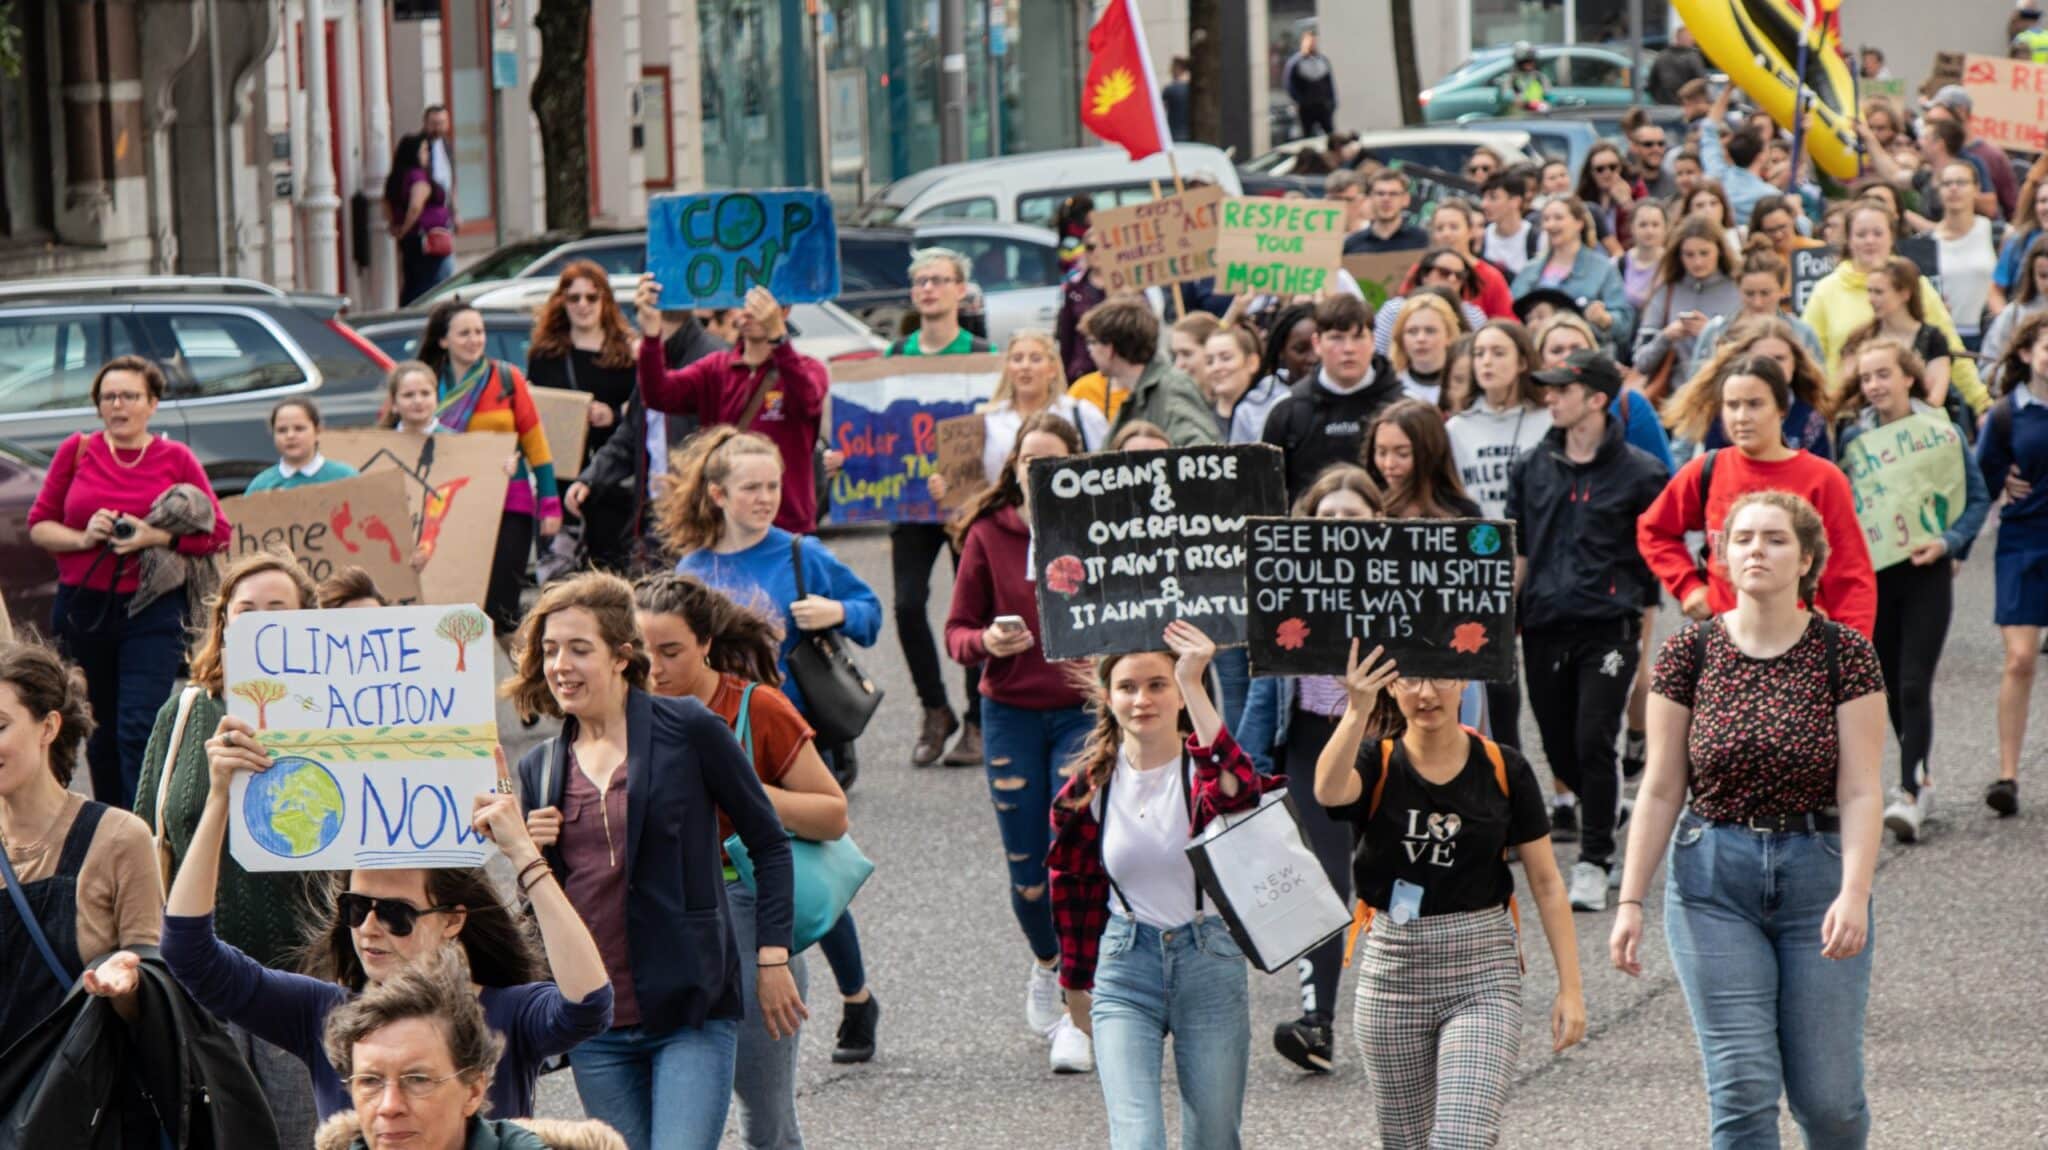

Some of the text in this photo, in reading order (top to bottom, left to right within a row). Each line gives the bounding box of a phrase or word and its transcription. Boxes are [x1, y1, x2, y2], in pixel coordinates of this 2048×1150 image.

[680, 193, 813, 252] COP
[1100, 202, 1218, 250] LITTLE ACT
[1225, 202, 1341, 232] RESPECT
[1256, 234, 1304, 253] YOUR
[687, 237, 777, 299] ON
[1225, 261, 1327, 293] MOTHER
[838, 421, 898, 458] Solar
[1896, 425, 1957, 457] Maths
[1051, 455, 1238, 499] OCEANS RISE
[1150, 483, 1176, 512] &
[1087, 514, 1247, 545] OVERFLOW
[1253, 525, 1457, 553] SEE HOW THE
[1084, 555, 1107, 585] IT
[1111, 547, 1179, 577] AIN'T
[1255, 557, 1513, 587] COULD BE IN SPITE
[1159, 575, 1185, 601] &
[1256, 588, 1511, 614] OF THE WAY THAT
[1069, 603, 1097, 630] IT
[1346, 613, 1413, 638] IT IS
[255, 623, 421, 675] CLIMATE
[326, 682, 455, 729] ACTION
[360, 773, 496, 850] NOW
[1252, 864, 1294, 895] NEW
[1256, 873, 1306, 908] LOOK
